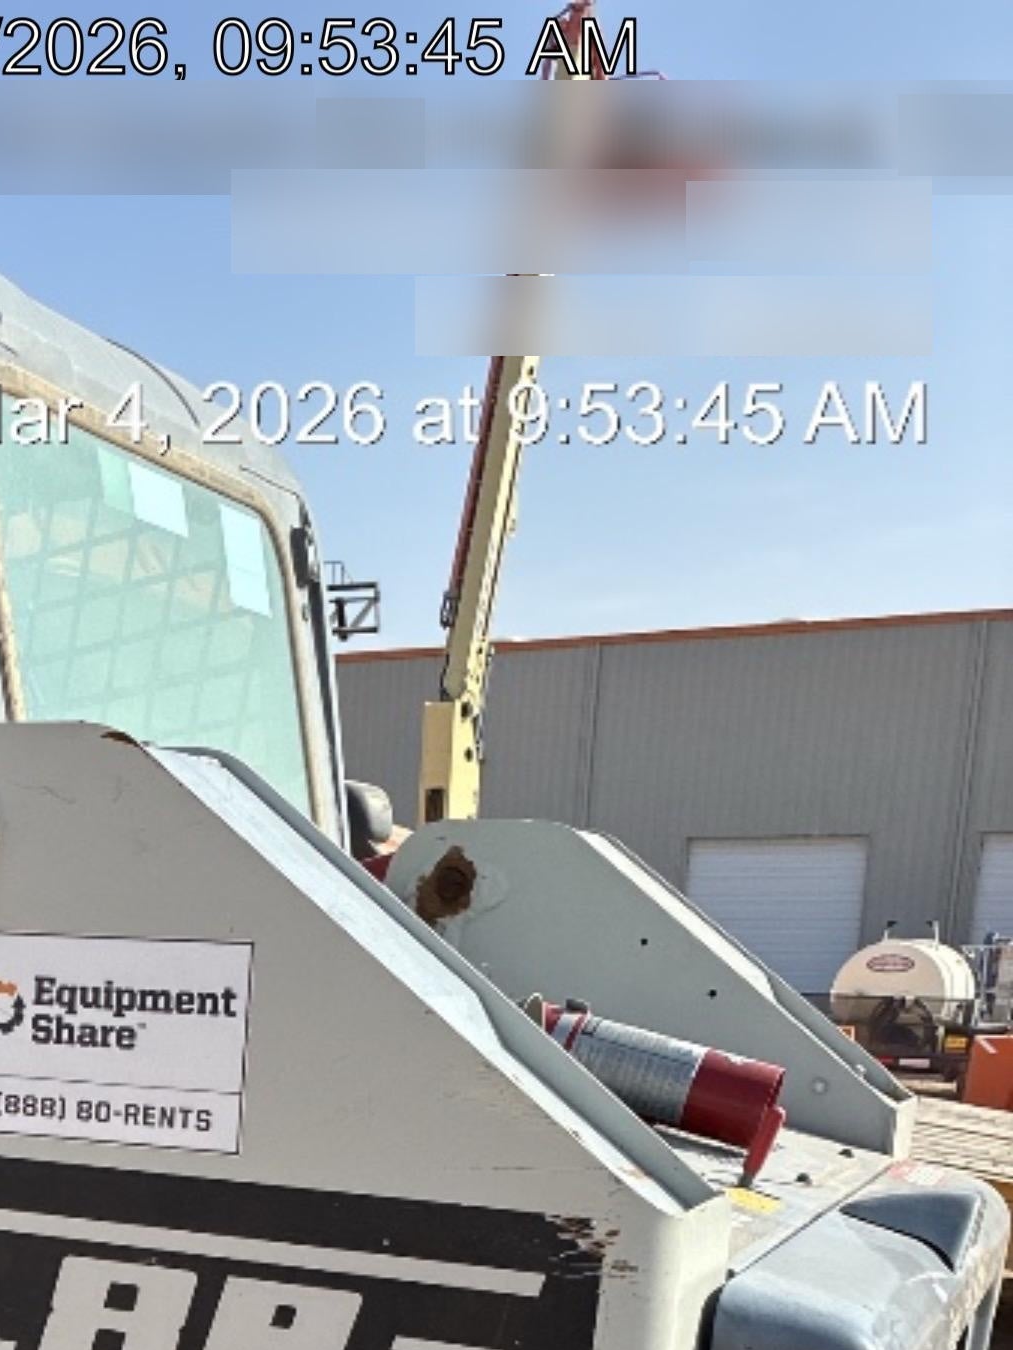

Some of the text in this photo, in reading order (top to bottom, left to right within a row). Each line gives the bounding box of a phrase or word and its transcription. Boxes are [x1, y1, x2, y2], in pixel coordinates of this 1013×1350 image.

[33, 975, 237, 1018] Equipment
[31, 1013, 136, 1049] Share
[76, 1100, 213, 1132] 80-RENTS
